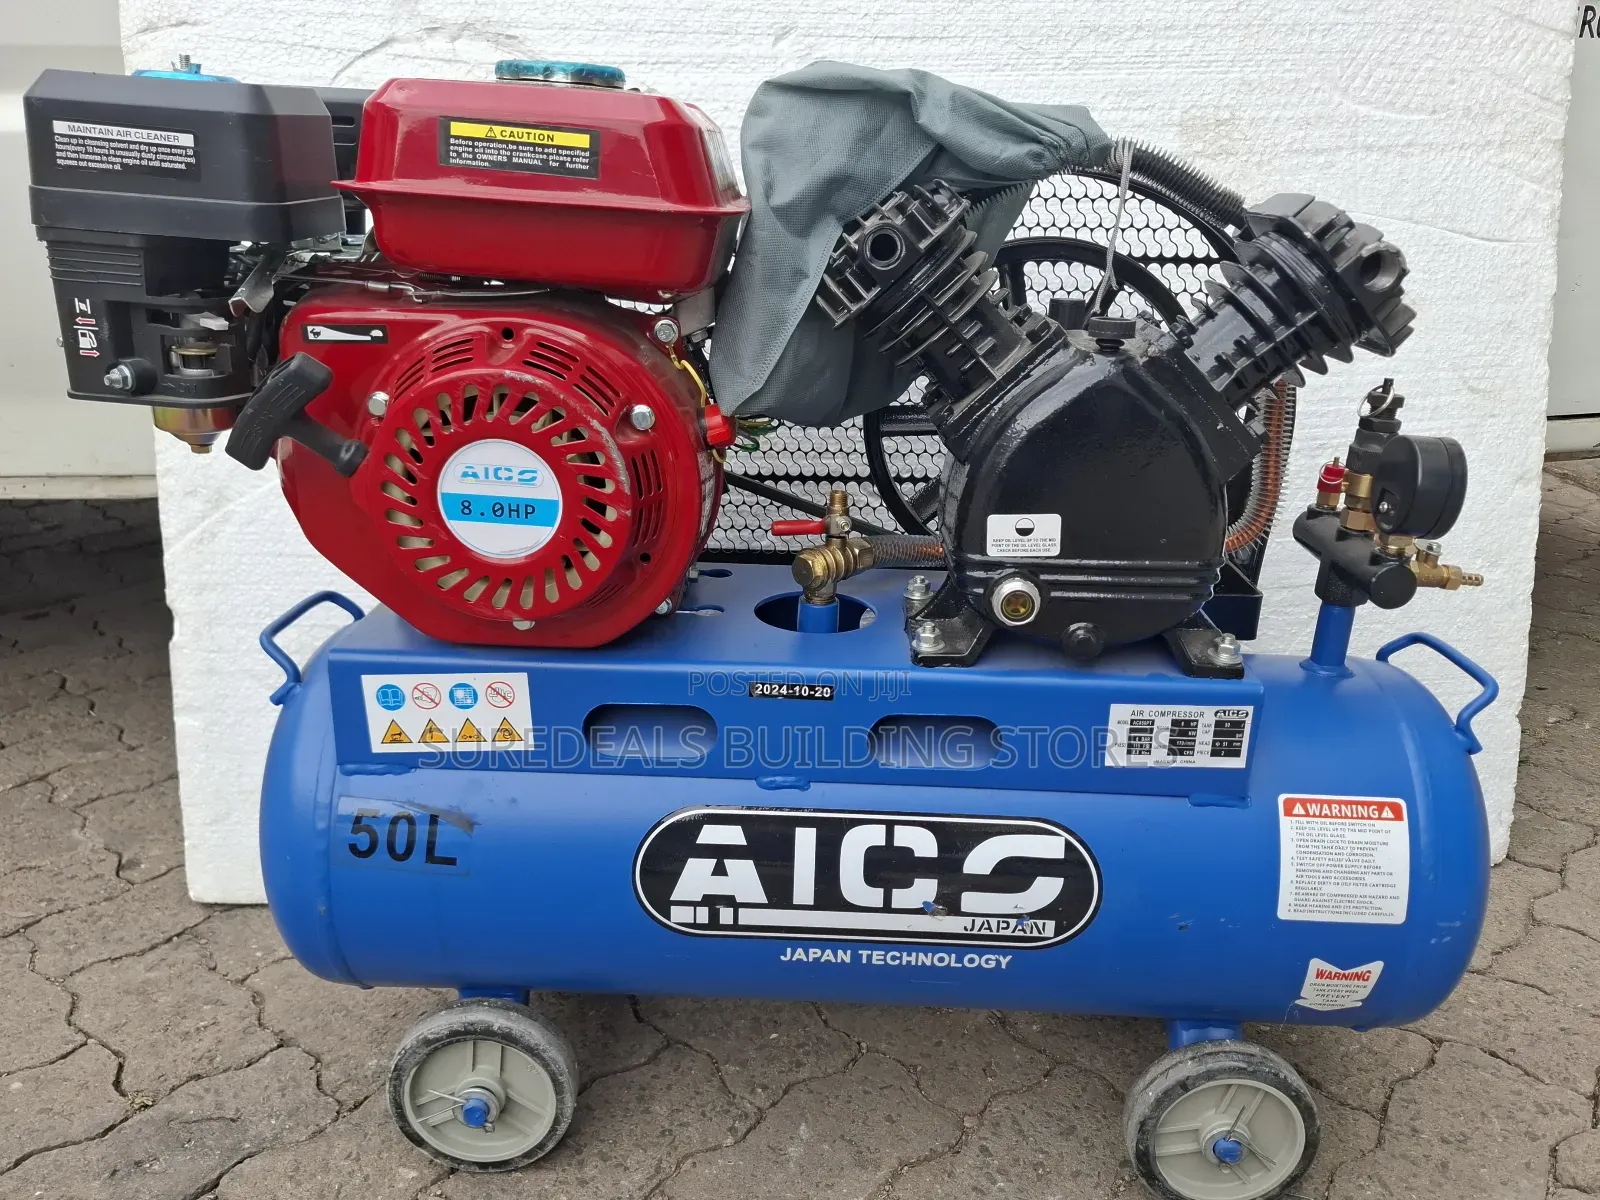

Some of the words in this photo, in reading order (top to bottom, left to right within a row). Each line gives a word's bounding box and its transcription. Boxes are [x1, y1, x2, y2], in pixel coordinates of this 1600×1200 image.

[67, 124, 114, 136] MAINTAIN
[116, 129, 132, 138] AIR
[134, 131, 180, 143] CLEANER
[500, 130, 554, 142] CAUTION
[84, 138, 109, 149] cleansing
[109, 141, 128, 149] solvent
[140, 144, 149, 153] dry
[171, 149, 186, 157] every
[116, 149, 140, 159] unusually
[141, 151, 156, 160] dusty
[450, 144, 473, 154] engine
[558, 148, 590, 158] specified
[56, 158, 78, 167] squeeze
[88, 161, 113, 169] excessive
[79, 152, 101, 161] immerse
[122, 157, 140, 166] engine
[450, 158, 491, 166] information.
[476, 153, 508, 162] OWNERS
[512, 157, 542, 165] MANUAL
[461, 466, 537, 482] AICS
[461, 500, 536, 519] 8.0HP
[754, 684, 831, 697] 2024-10-20
[1307, 802, 1378, 818] WARNING
[348, 808, 457, 866] 50L
[669, 824, 1065, 914] AICS
[963, 918, 1047, 936] JAPAN
[781, 947, 851, 964] JAPAN
[859, 950, 1012, 970] TECHNOLOGY
[1316, 968, 1372, 982] WARNING
